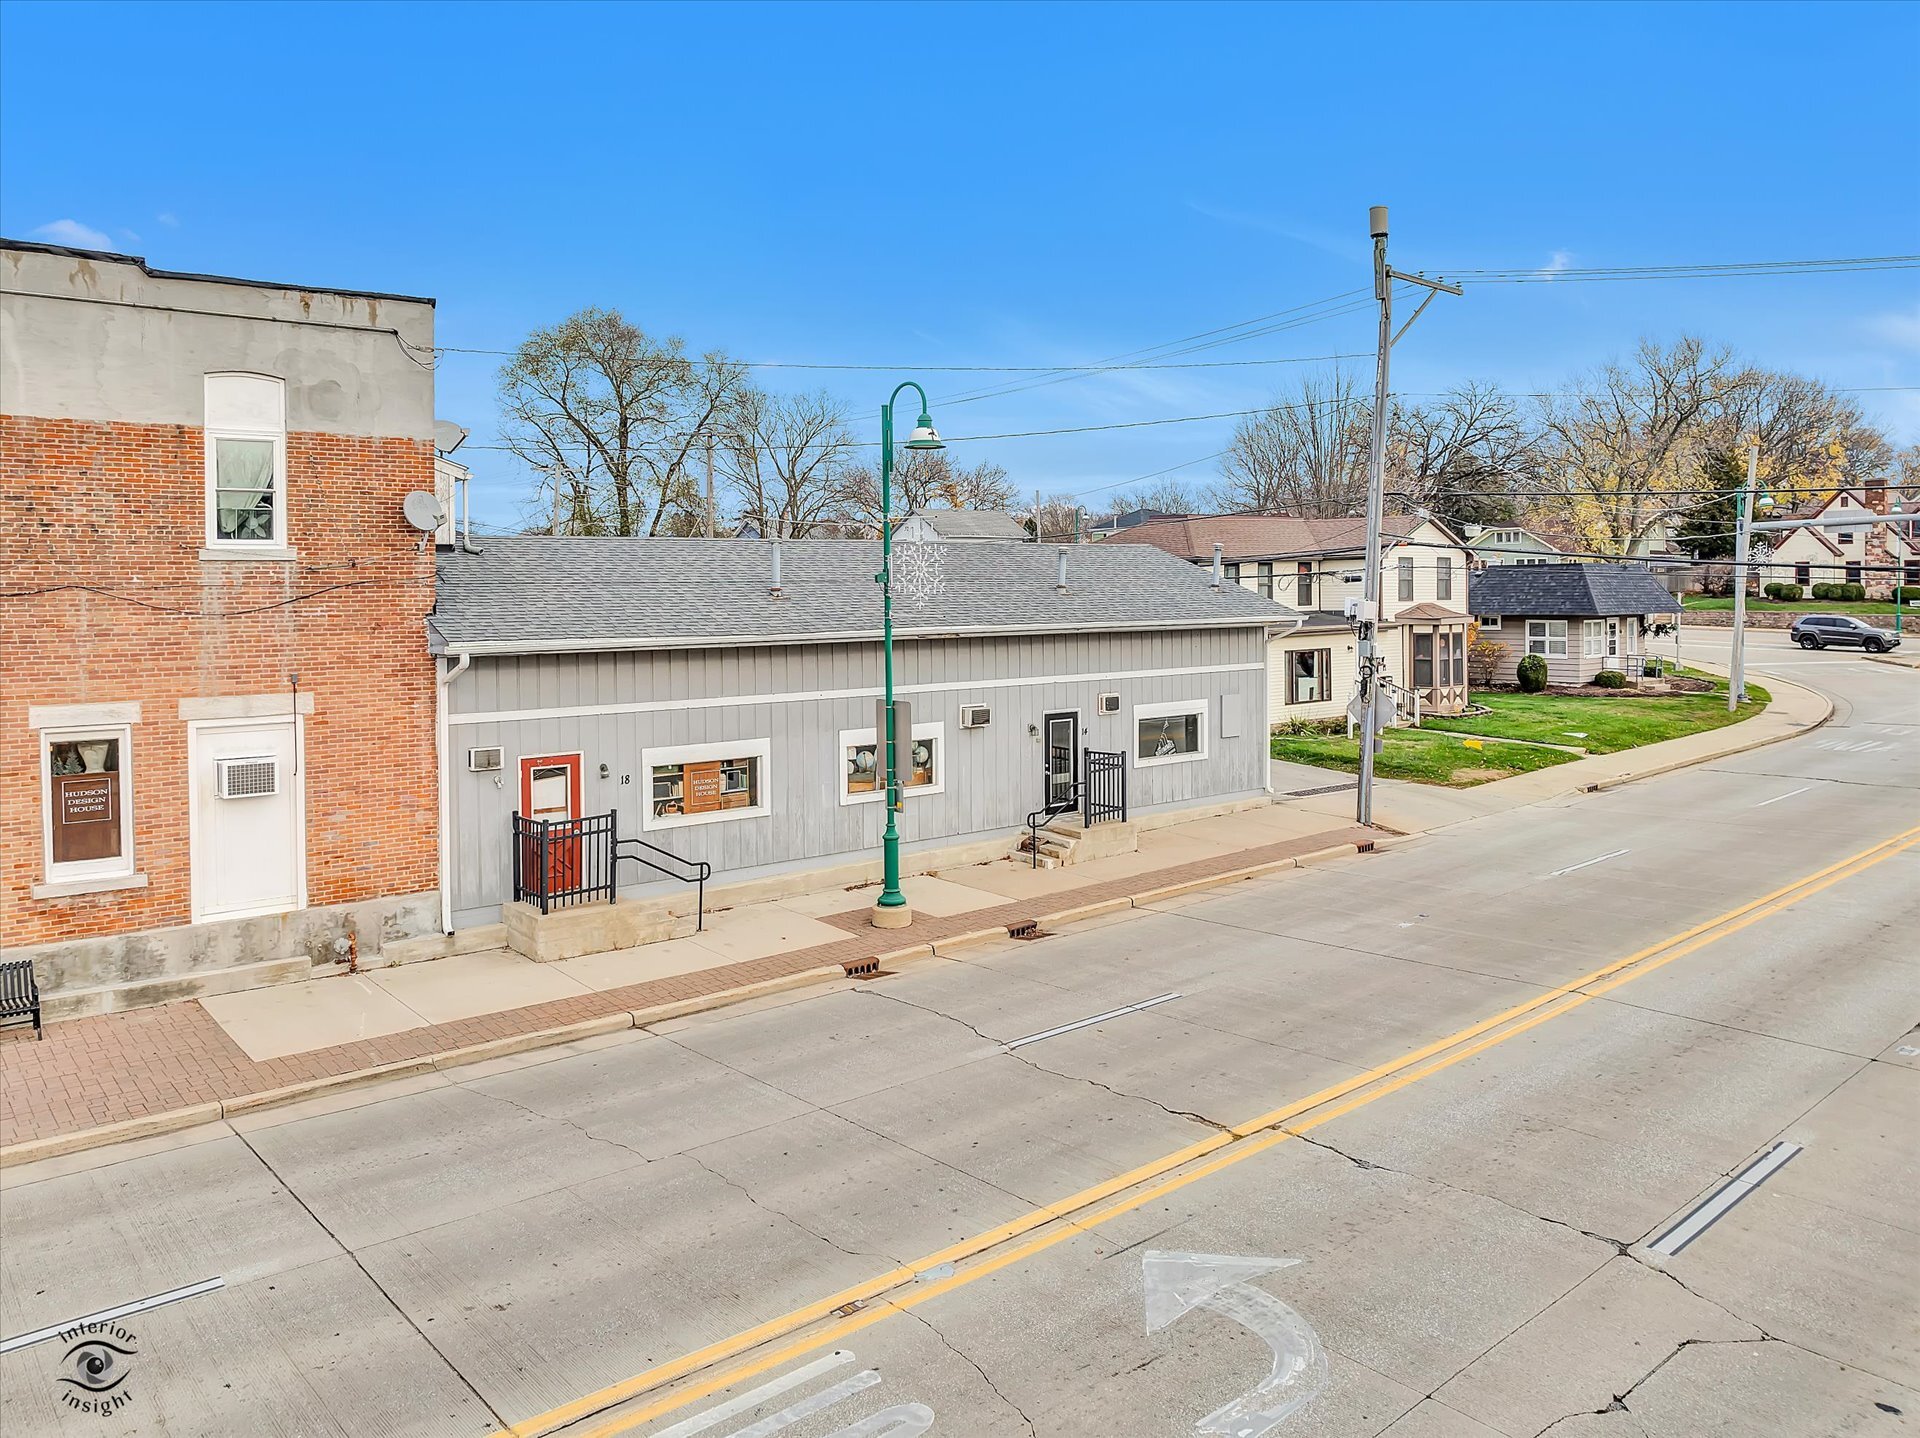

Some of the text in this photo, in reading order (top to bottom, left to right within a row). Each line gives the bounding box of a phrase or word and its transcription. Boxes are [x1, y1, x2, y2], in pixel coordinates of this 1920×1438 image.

[620, 774, 630, 785] 18
[693, 777, 719, 785] HUDSON
[65, 788, 108, 798] HUDSON
[67, 796, 106, 806] DESIGN
[69, 804, 105, 813] HOUSE
